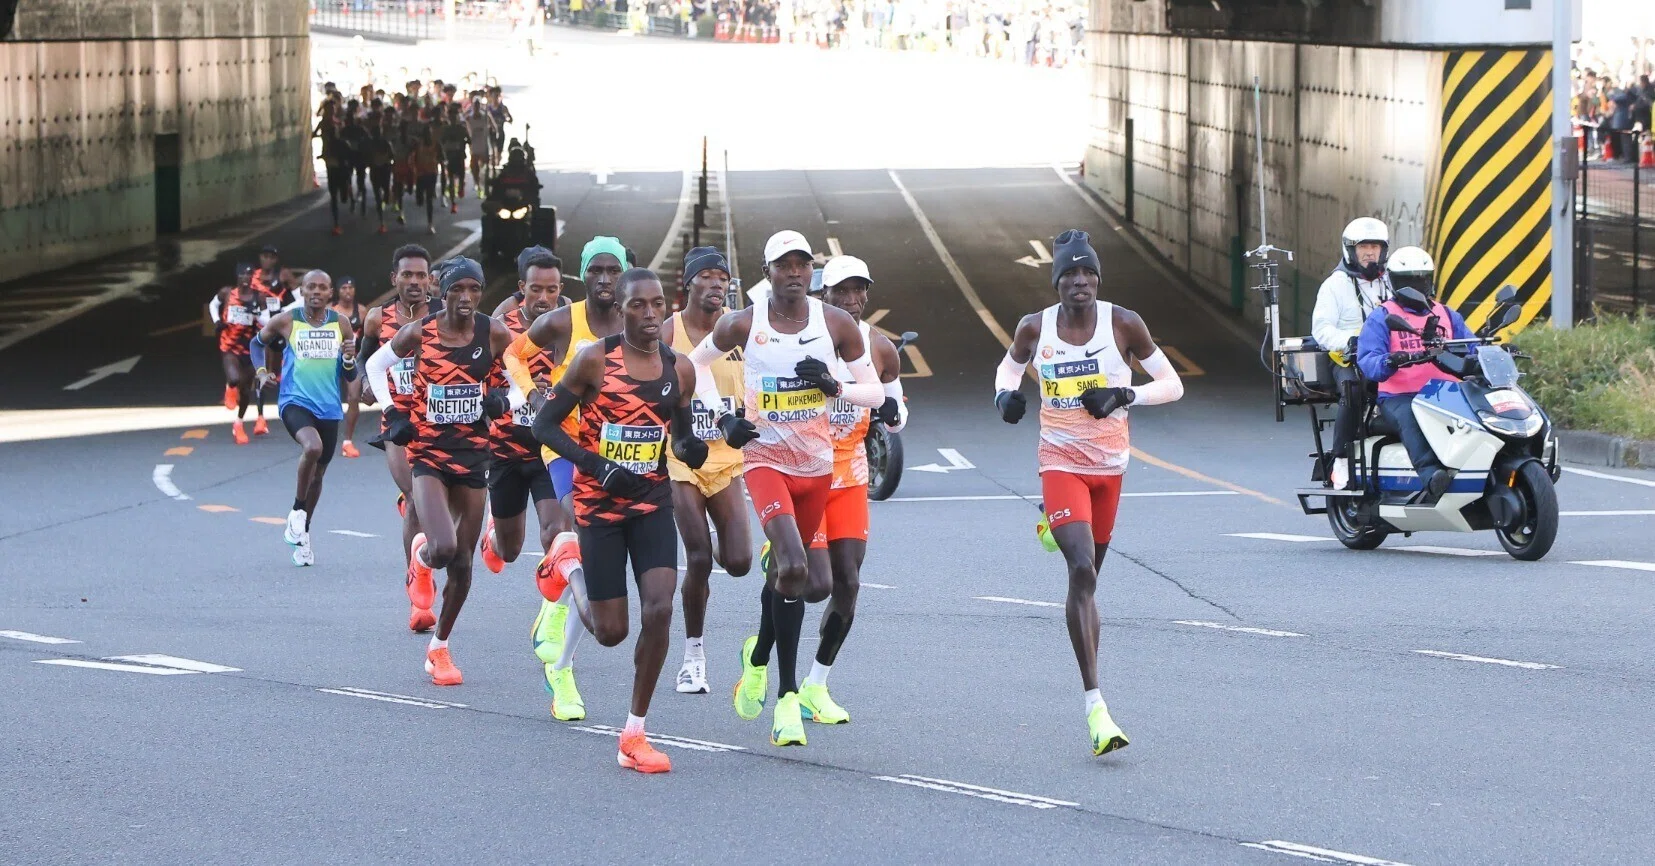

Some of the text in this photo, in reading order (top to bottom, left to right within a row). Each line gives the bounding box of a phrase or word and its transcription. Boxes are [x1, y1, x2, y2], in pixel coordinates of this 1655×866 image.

[297, 340, 333, 351] NGANDU
[1057, 363, 1096, 375] 東京メトロ
[447, 388, 480, 396] 東京メトロ
[1045, 380, 1099, 396] P2 SANG
[429, 398, 477, 413] NGETICH
[787, 393, 823, 406] KIPKEMBOI
[1061, 397, 1081, 408] STA
[691, 414, 714, 430] PRU
[830, 413, 855, 424] TARTS
[625, 430, 660, 439] 東京メトロ
[605, 441, 657, 461] PACE 3
[1049, 508, 1071, 523] EOS
